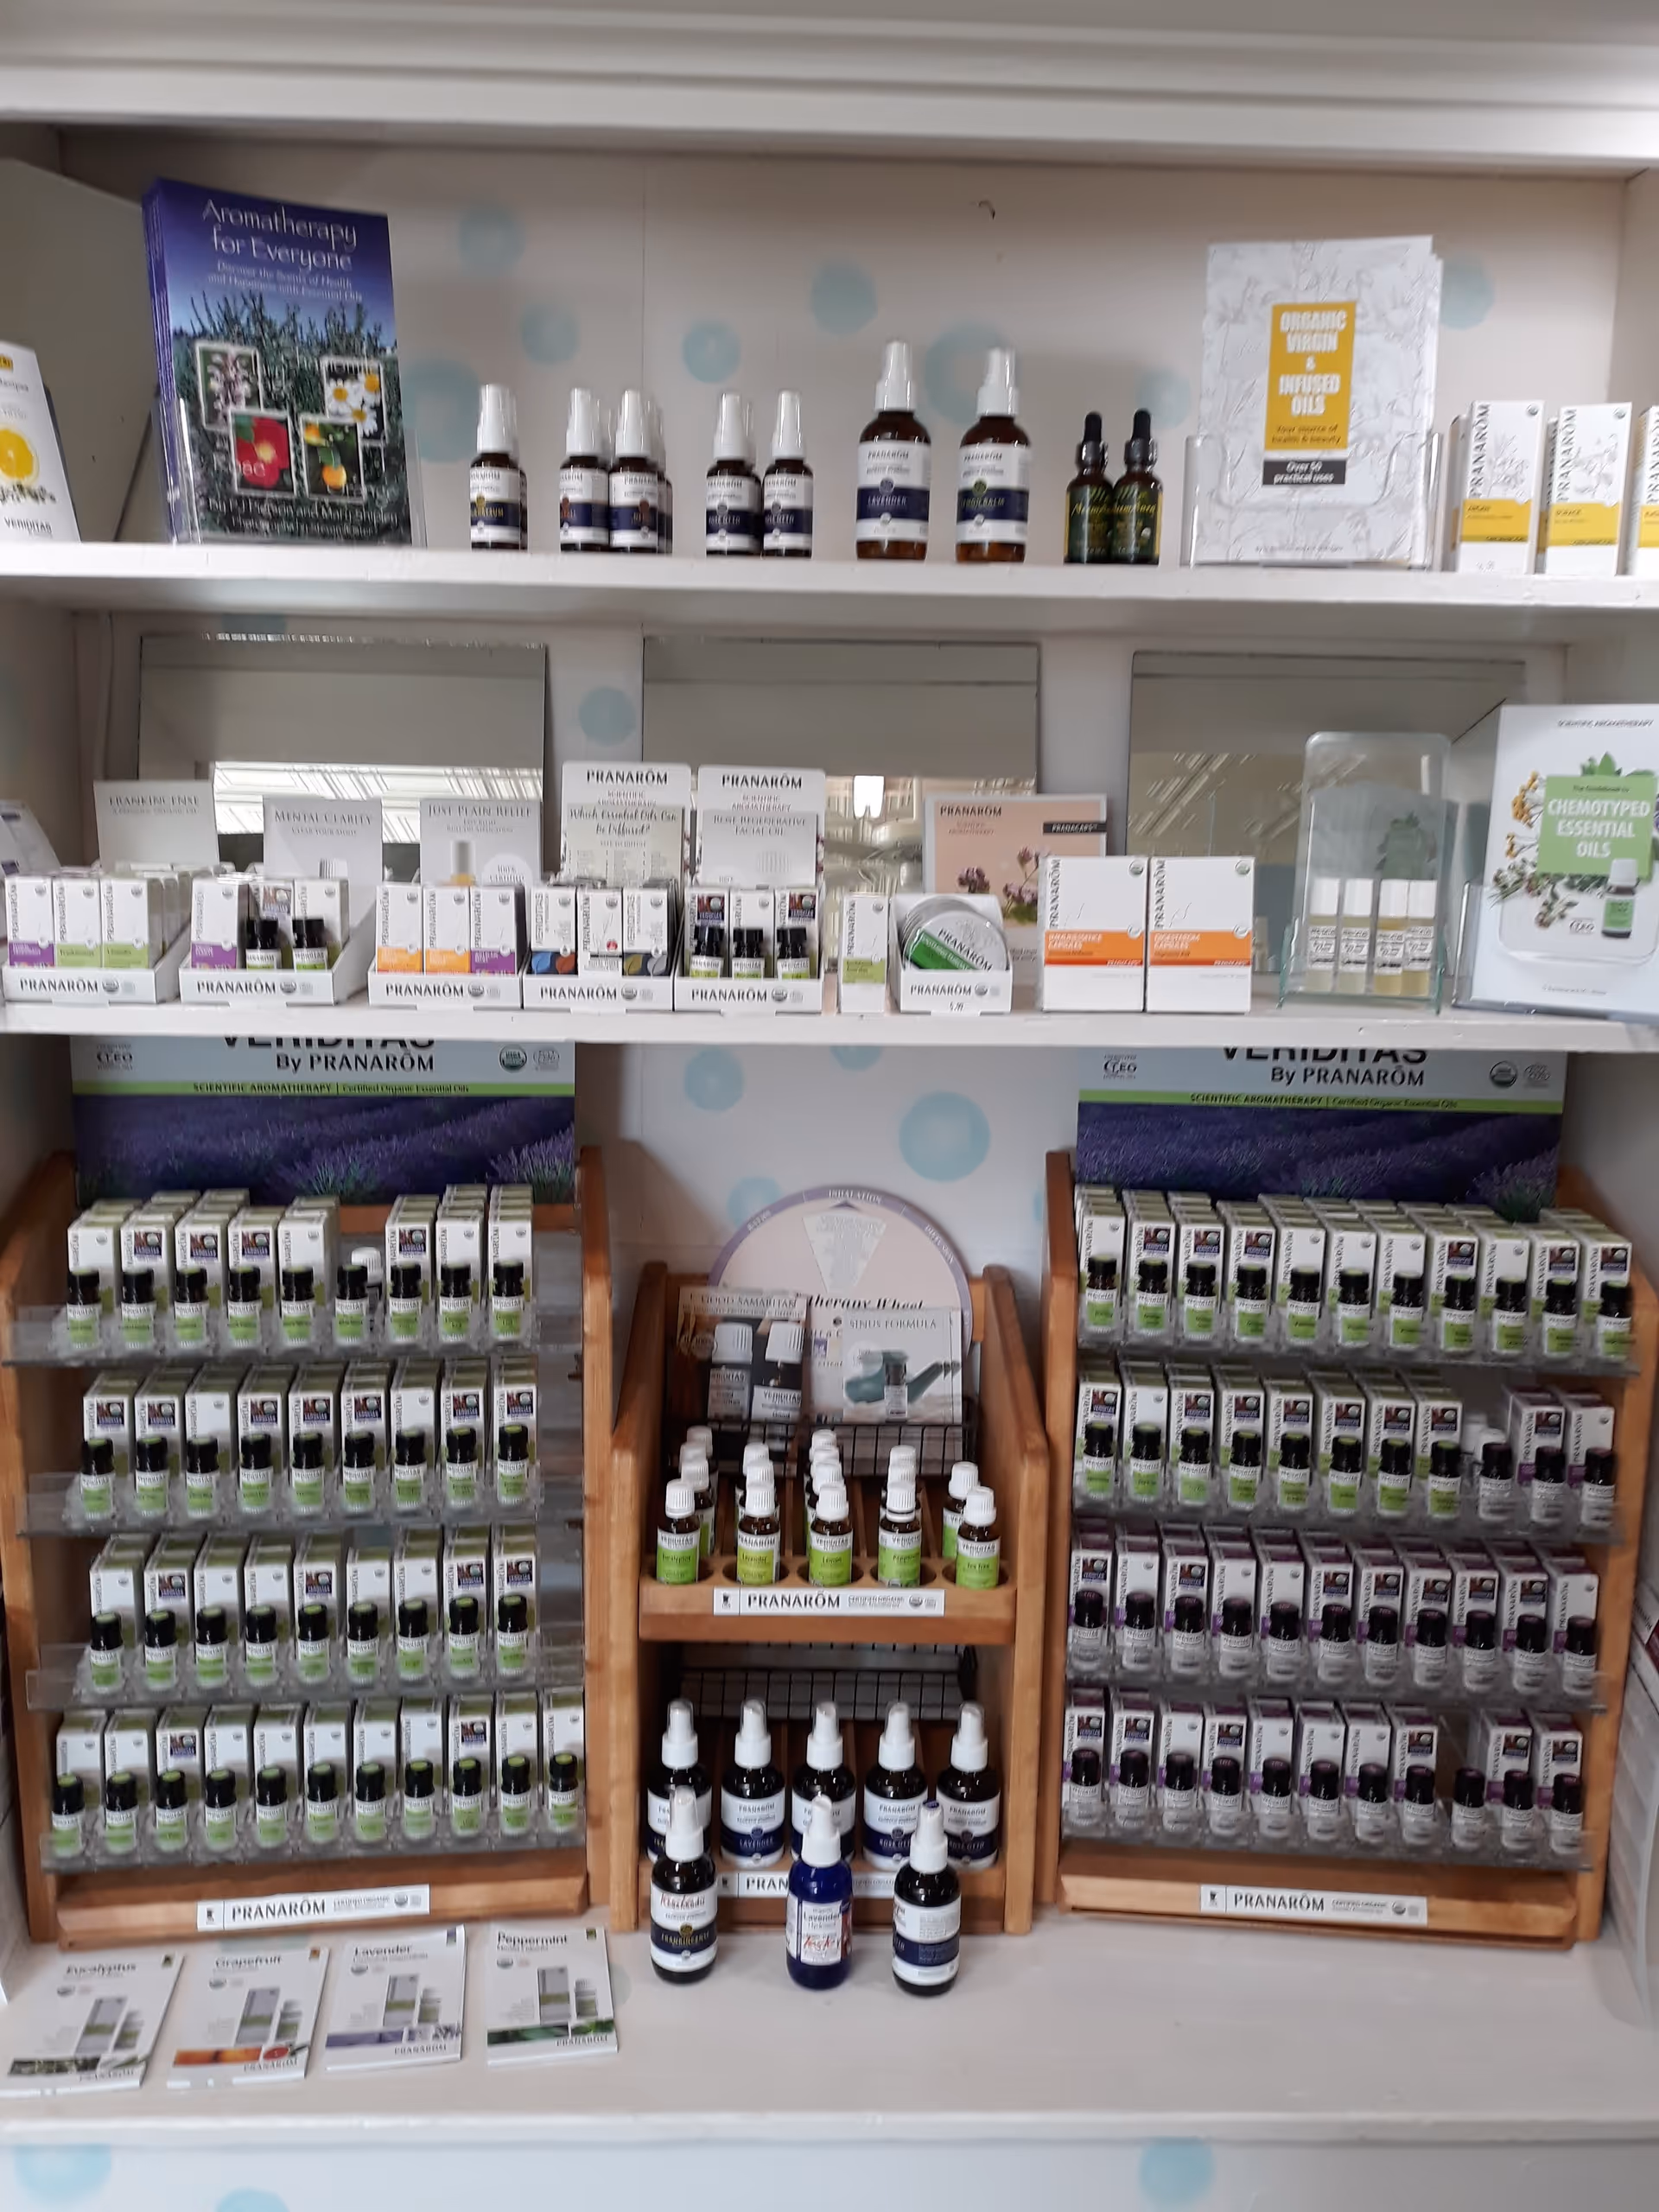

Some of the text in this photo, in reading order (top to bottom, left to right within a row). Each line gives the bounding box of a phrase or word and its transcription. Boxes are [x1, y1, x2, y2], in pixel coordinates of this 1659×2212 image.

[202, 198, 357, 253] Aromatherapy
[213, 224, 353, 271] for Everyone
[1281, 310, 1347, 333] ORGANIC
[1287, 332, 1338, 354] VIRGIN
[1279, 374, 1342, 395] INFUSED
[1291, 395, 1326, 416] OILS
[587, 769, 668, 785] PRANARÔM
[721, 772, 803, 790] PRANARÔM
[428, 804, 454, 818] JUST
[458, 805, 493, 817] PLAIN
[940, 804, 1002, 817] PRANARÔM
[1548, 798, 1651, 817] CHEMOTYPED
[275, 810, 372, 825] MENTAL CLARITY
[1556, 819, 1636, 838] ESSENTIAL
[1576, 841, 1611, 858] OILS
[20, 976, 99, 993] PRANARÔM
[197, 978, 276, 995] PRANARÔM
[385, 980, 464, 998] PRANARÔM
[540, 982, 617, 1001] PRANARÔM
[910, 982, 972, 996] PRANARÔM
[690, 987, 768, 1003] PRANARÔM
[276, 1049, 434, 1074] By PRANARÔM
[1271, 1065, 1425, 1087] By PRANARÔM
[251, 1083, 331, 1094] AROMATHERAPY
[1243, 1094, 1324, 1106] AROMATHERAPY
[747, 1590, 840, 1609] PRANARÔM
[232, 1896, 327, 1923] PRANARÔM
[1234, 1892, 1325, 1912] PRANARÔM
[497, 1931, 569, 1946] Peppermint
[354, 1943, 413, 1957] Lavender
[66, 1962, 137, 1976] Eucalyptus
[215, 1955, 283, 1968] Grapefruit
